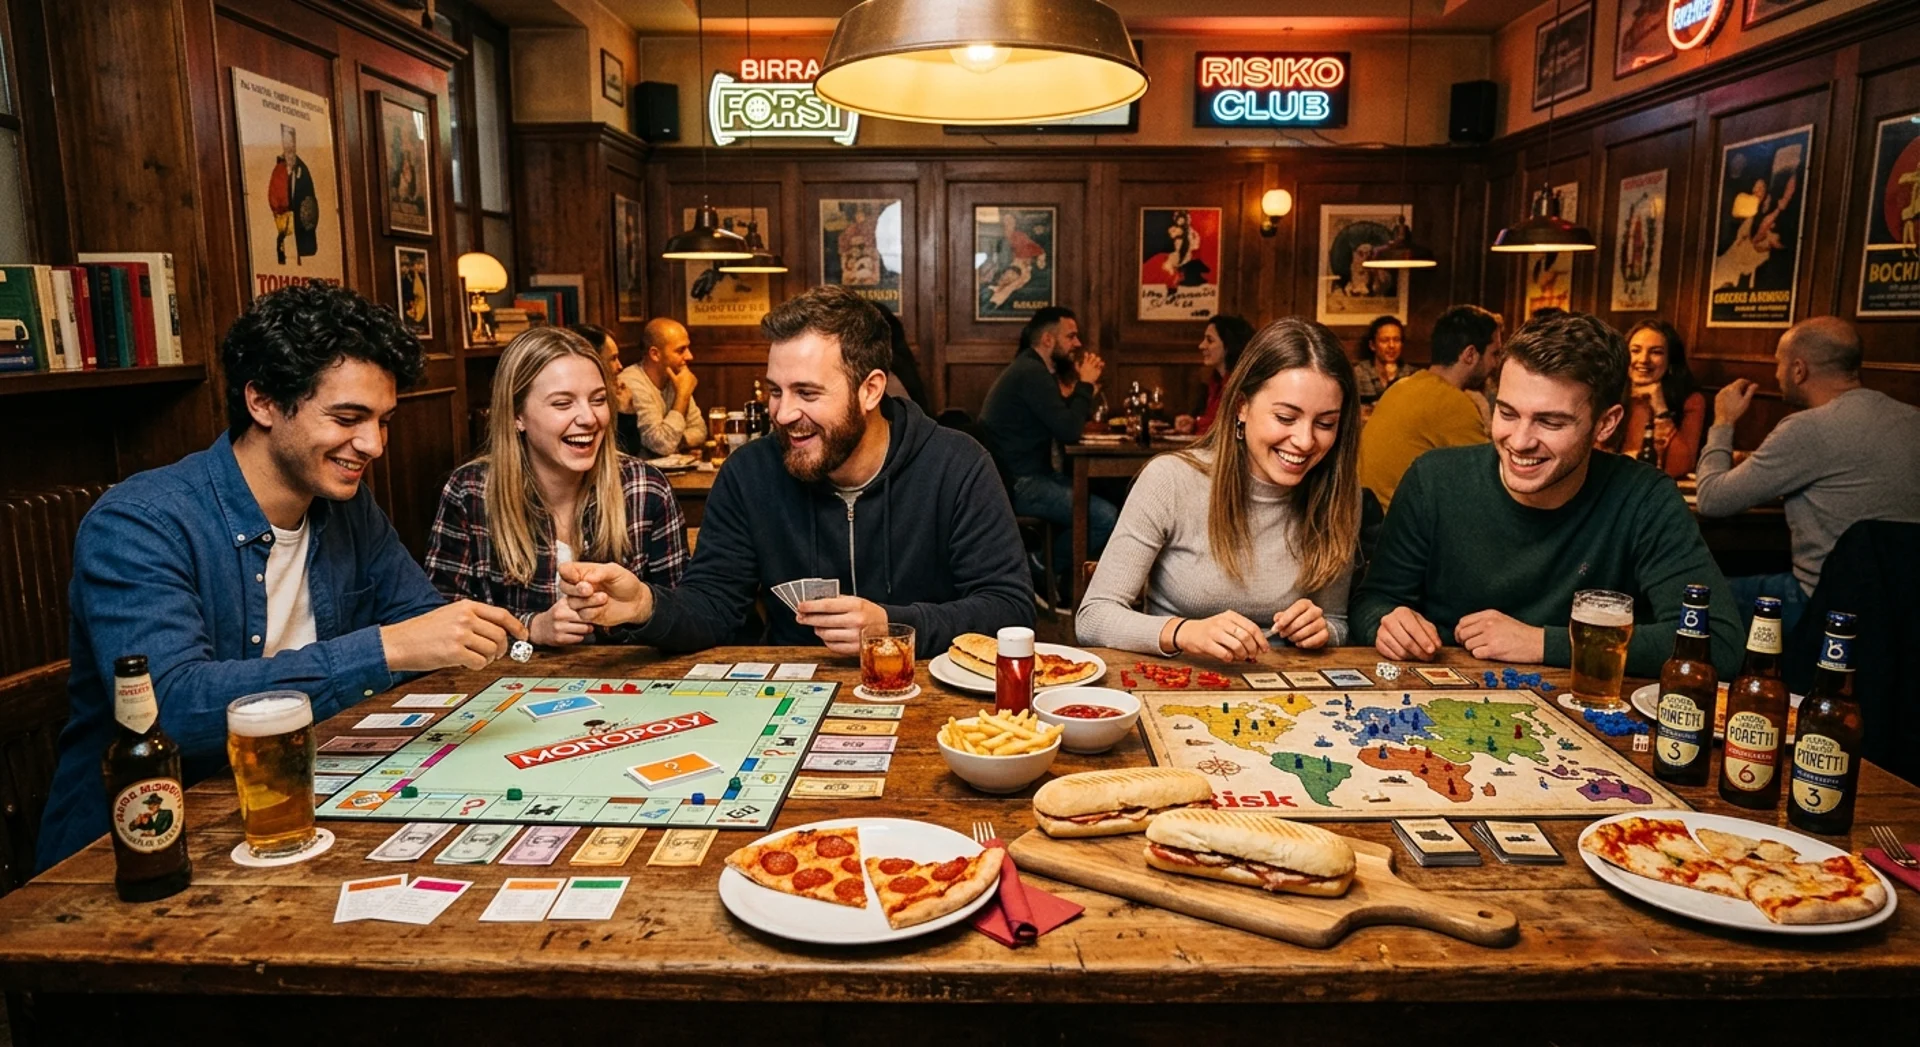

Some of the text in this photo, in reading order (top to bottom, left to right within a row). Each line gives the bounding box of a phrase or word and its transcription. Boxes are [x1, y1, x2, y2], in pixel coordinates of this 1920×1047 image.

[741, 59, 820, 80] BIRRA
[1202, 57, 1345, 88] RISIKO
[1213, 90, 1330, 121] CLUB
[519, 714, 702, 765] MONOPOLY
[1738, 764, 1755, 783] 6
[1804, 787, 1821, 807] 3
